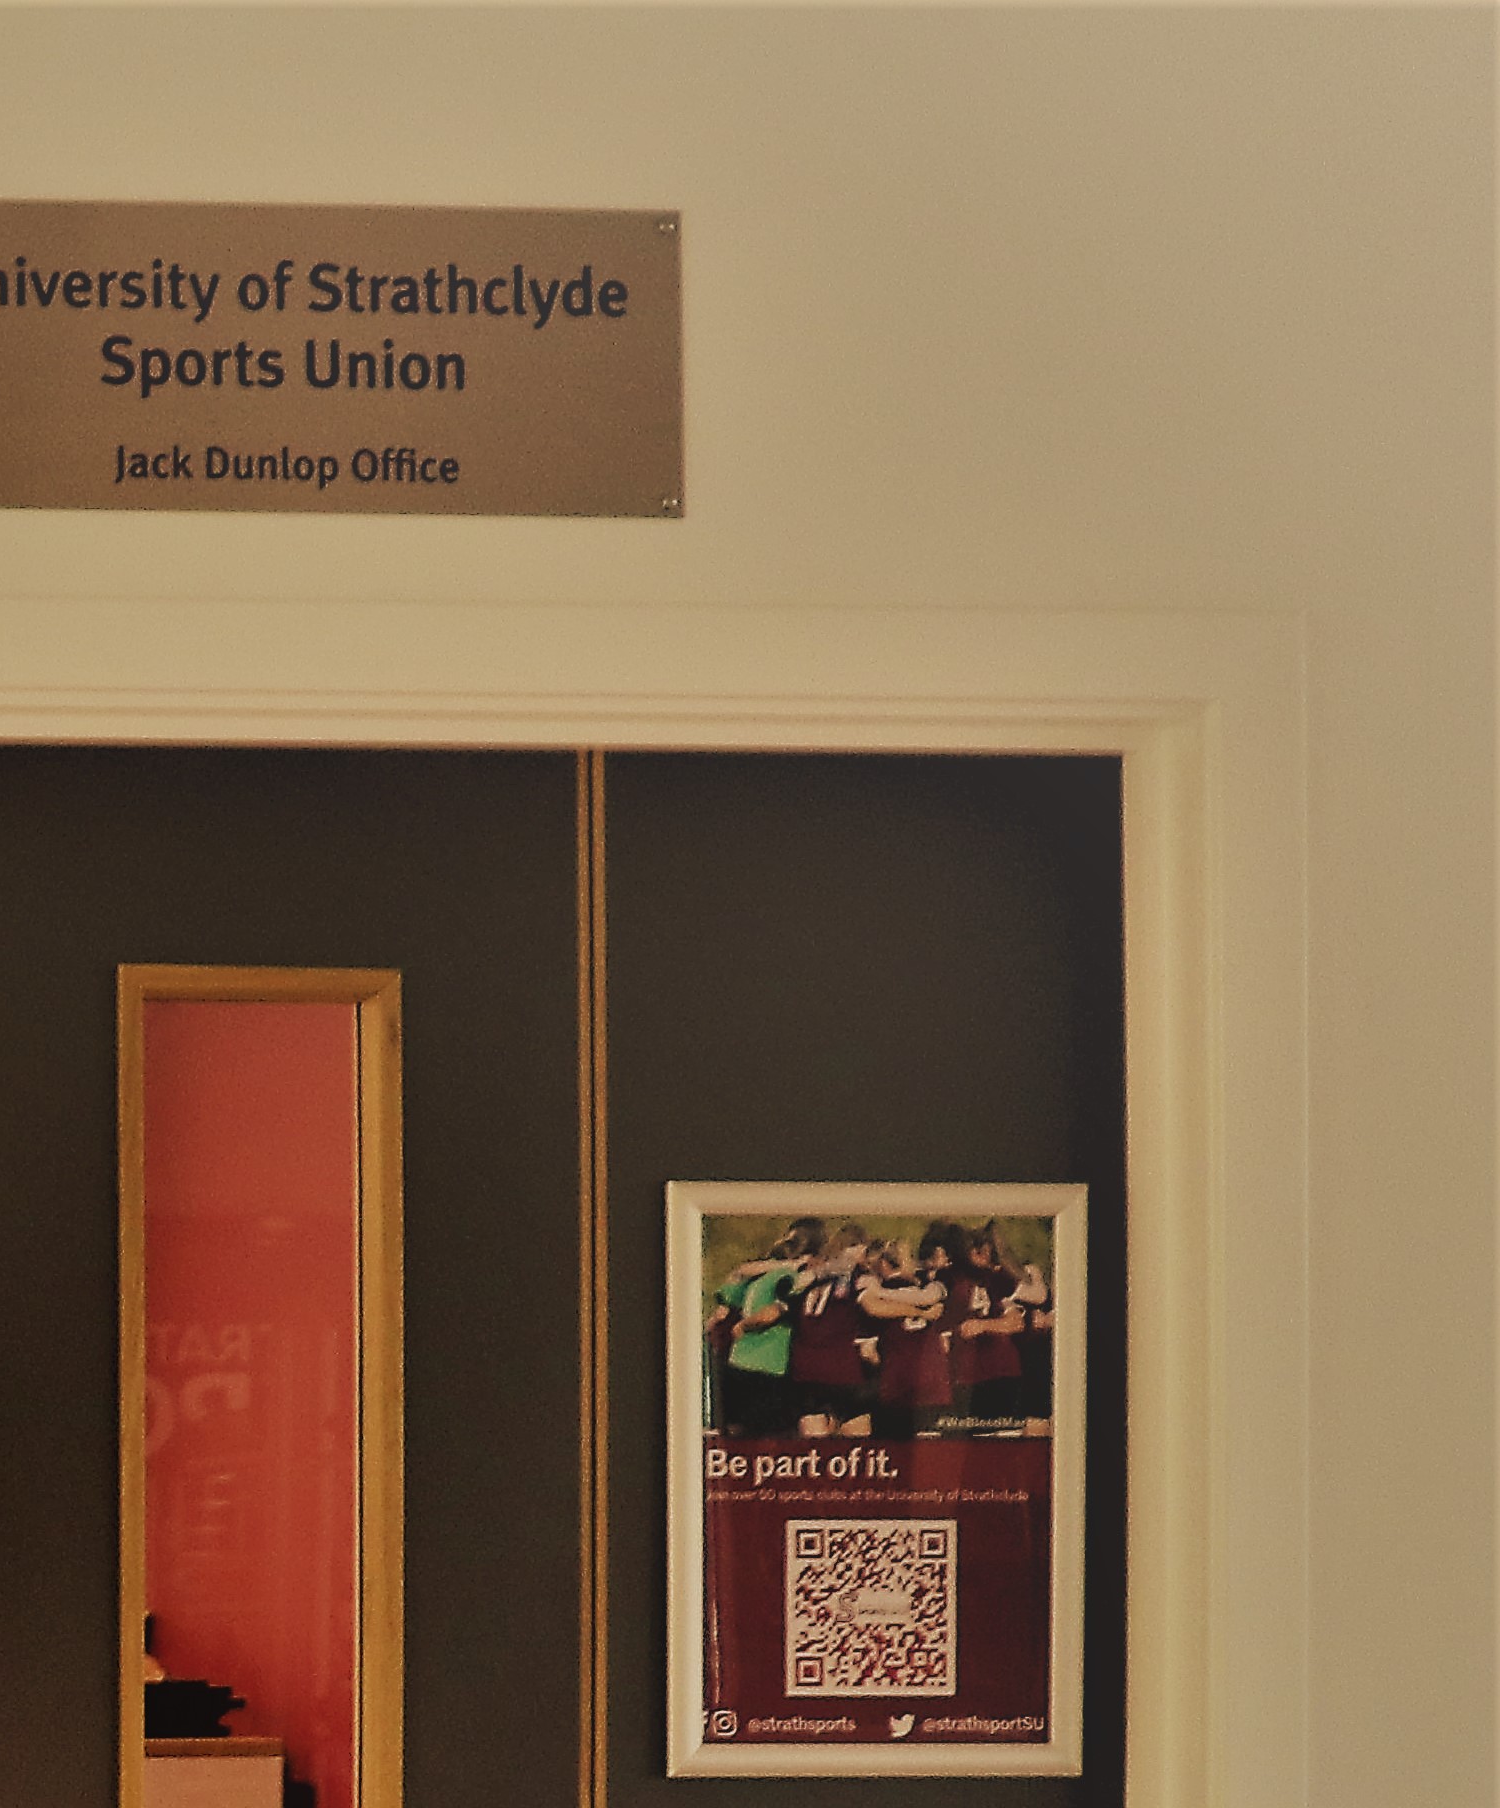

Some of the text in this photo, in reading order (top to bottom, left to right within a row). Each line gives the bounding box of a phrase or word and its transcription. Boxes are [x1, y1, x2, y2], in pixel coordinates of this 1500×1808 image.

[237, 260, 293, 311] of
[309, 263, 628, 329] Strathclyde
[101, 336, 465, 399] Sports Union
[115, 445, 459, 490] Jack Dunlop Office
[707, 1447, 898, 1486] Be part of it.
